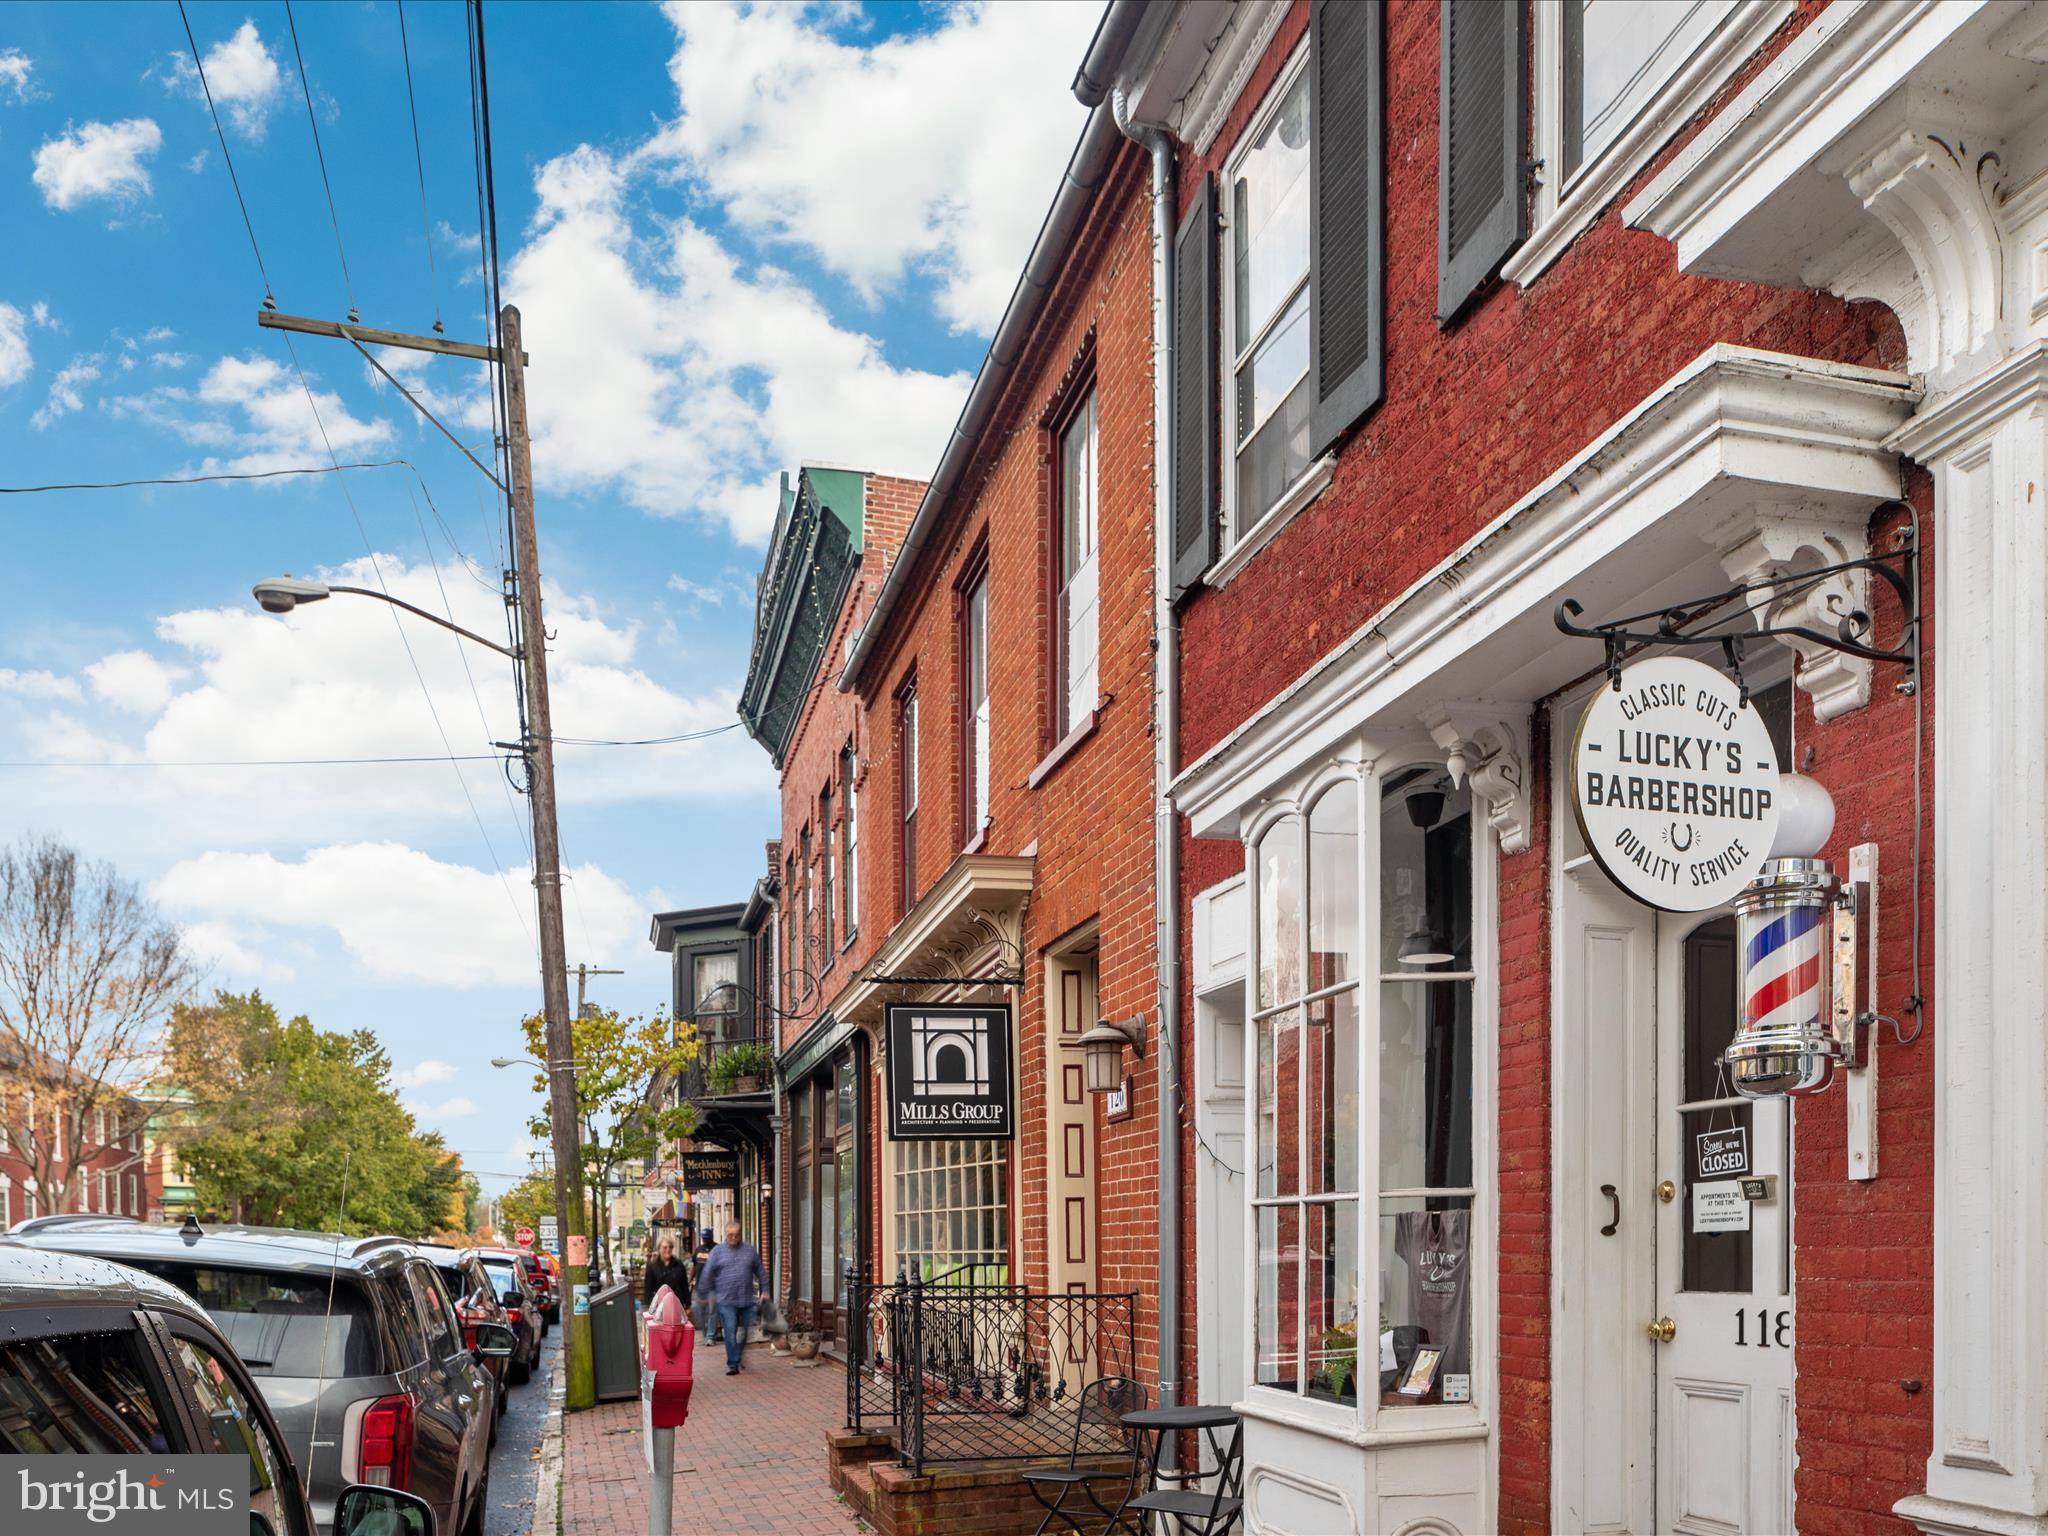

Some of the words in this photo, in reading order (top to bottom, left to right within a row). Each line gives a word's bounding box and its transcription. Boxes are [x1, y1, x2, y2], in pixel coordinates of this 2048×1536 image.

[1620, 683, 1686, 721] CLASSIC
[1696, 690, 1737, 731] CUTS
[1618, 729, 1742, 775] LUCKY'S
[1587, 772, 1772, 821] BARBERSHOP
[1615, 828, 1681, 885] QUALITY
[1690, 838, 1750, 887] SERVICE
[900, 1102, 950, 1120] MILLS
[952, 1101, 1004, 1120] GROUP
[1702, 1152, 1744, 1172] CLOSED
[702, 1170, 722, 1179] INN
[1700, 1192, 1731, 1200] APPOINTMENTS
[516, 1233, 533, 1241] STOP
[540, 1228, 558, 1237] 230
[1734, 1307, 1790, 1348] 118
